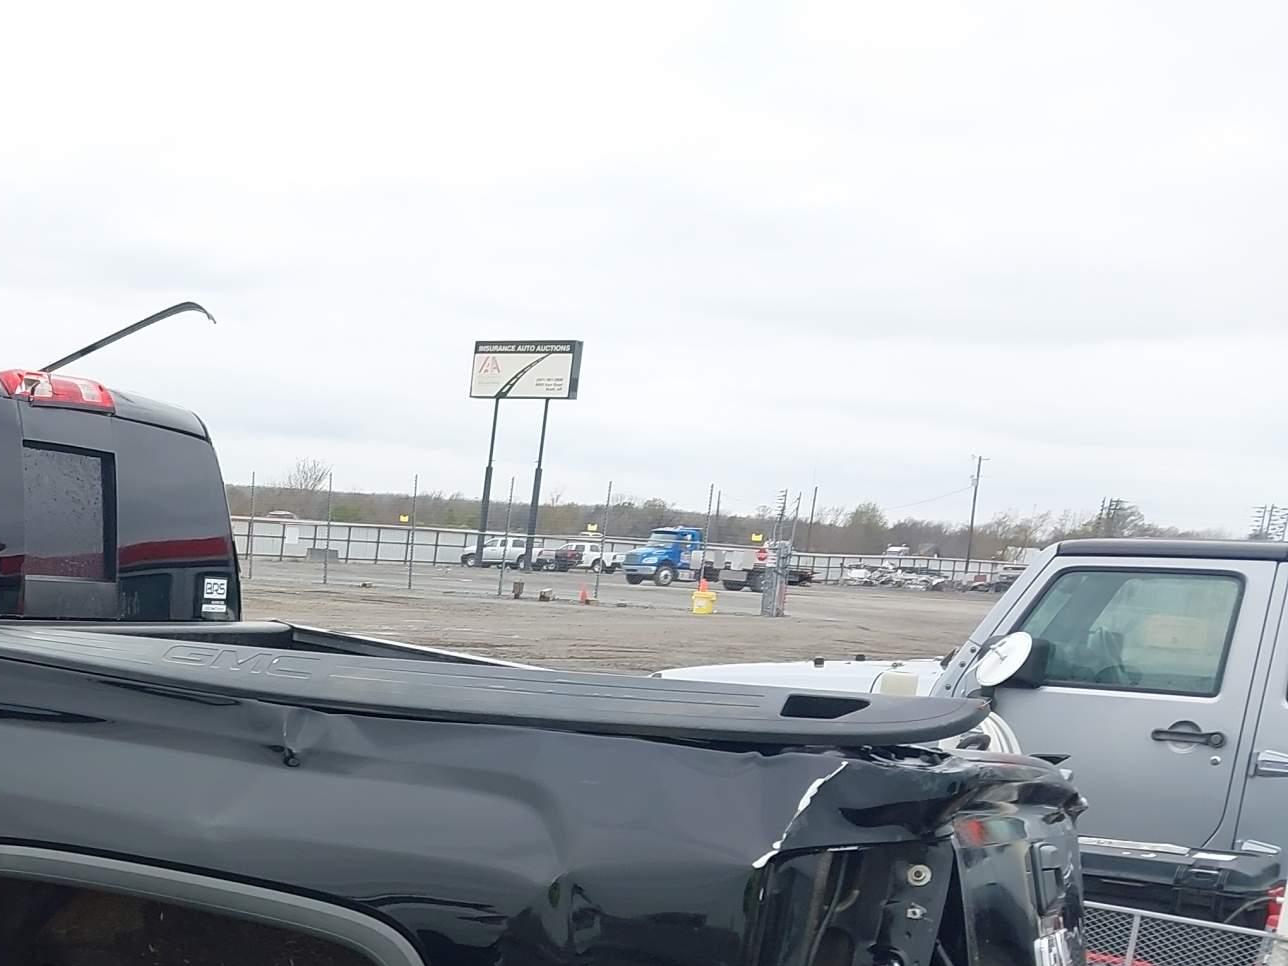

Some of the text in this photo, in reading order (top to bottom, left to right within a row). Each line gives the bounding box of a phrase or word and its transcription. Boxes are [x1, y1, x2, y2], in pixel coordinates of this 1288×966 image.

[478, 344, 516, 352] INSURANCE
[517, 344, 536, 352] AUTO
[163, 645, 321, 679] GMC
